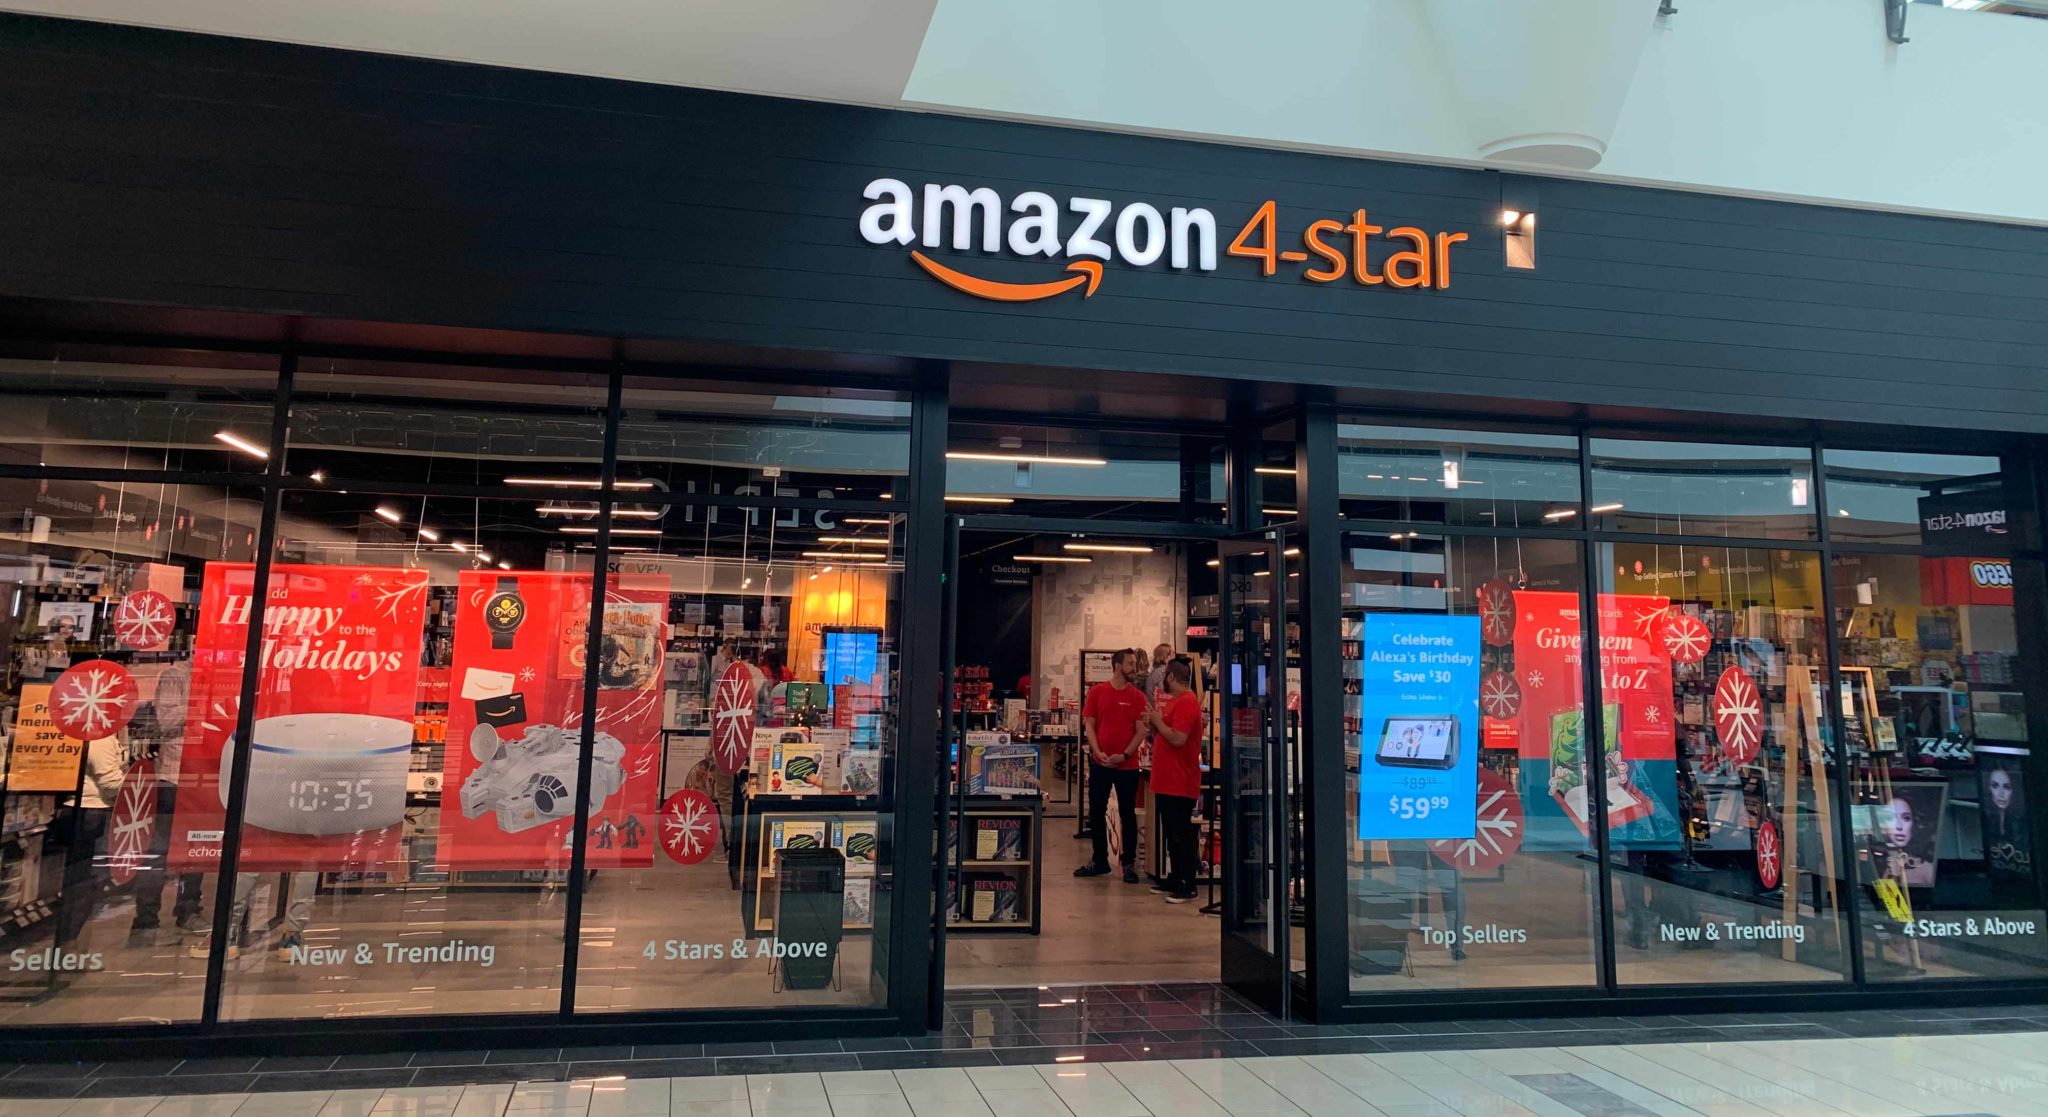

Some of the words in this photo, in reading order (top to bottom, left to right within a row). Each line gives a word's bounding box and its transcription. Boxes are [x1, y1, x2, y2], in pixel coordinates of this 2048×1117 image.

[859, 178, 1217, 271] amazon
[1226, 200, 1468, 290] 4-star
[991, 565, 1030, 574] Checkout
[271, 588, 289, 599] dd
[216, 594, 343, 637] Hppy
[1560, 609, 1579, 617] amaz
[1603, 608, 1624, 618] cards
[338, 626, 352, 635] to
[355, 624, 376, 635] the
[1392, 633, 1454, 646] Celebrate
[1536, 628, 1580, 650] Give
[1600, 636, 1633, 650] em
[1371, 651, 1416, 663] Alexa's
[1420, 651, 1474, 666] Birthday
[1612, 652, 1638, 665] from
[1393, 670, 1426, 683] Save
[1429, 669, 1452, 683] $30
[1612, 673, 1631, 689] to
[1634, 669, 1648, 689] Z
[35, 731, 65, 740] save
[15, 744, 54, 756] every
[57, 742, 82, 756] day
[288, 779, 373, 812] 10:35
[978, 819, 1021, 829] REVLON
[188, 846, 216, 857] echo
[974, 880, 1017, 890] REVLON
[1660, 925, 1702, 941] New
[1706, 924, 1720, 940] &
[1724, 921, 1805, 942] Trending
[1903, 922, 1914, 936] 4
[1919, 919, 1960, 937] Stars
[1965, 918, 1980, 934] &
[1984, 918, 2036, 935] Above
[1420, 926, 1457, 946] Top
[1462, 925, 1527, 945] Sellers
[289, 945, 347, 966] New
[354, 943, 374, 964] &
[382, 940, 496, 967] Trending
[642, 941, 657, 960] 4
[664, 940, 724, 961] Stars
[730, 939, 748, 958] &
[755, 938, 828, 958] Above
[9, 948, 103, 971] Sellers
